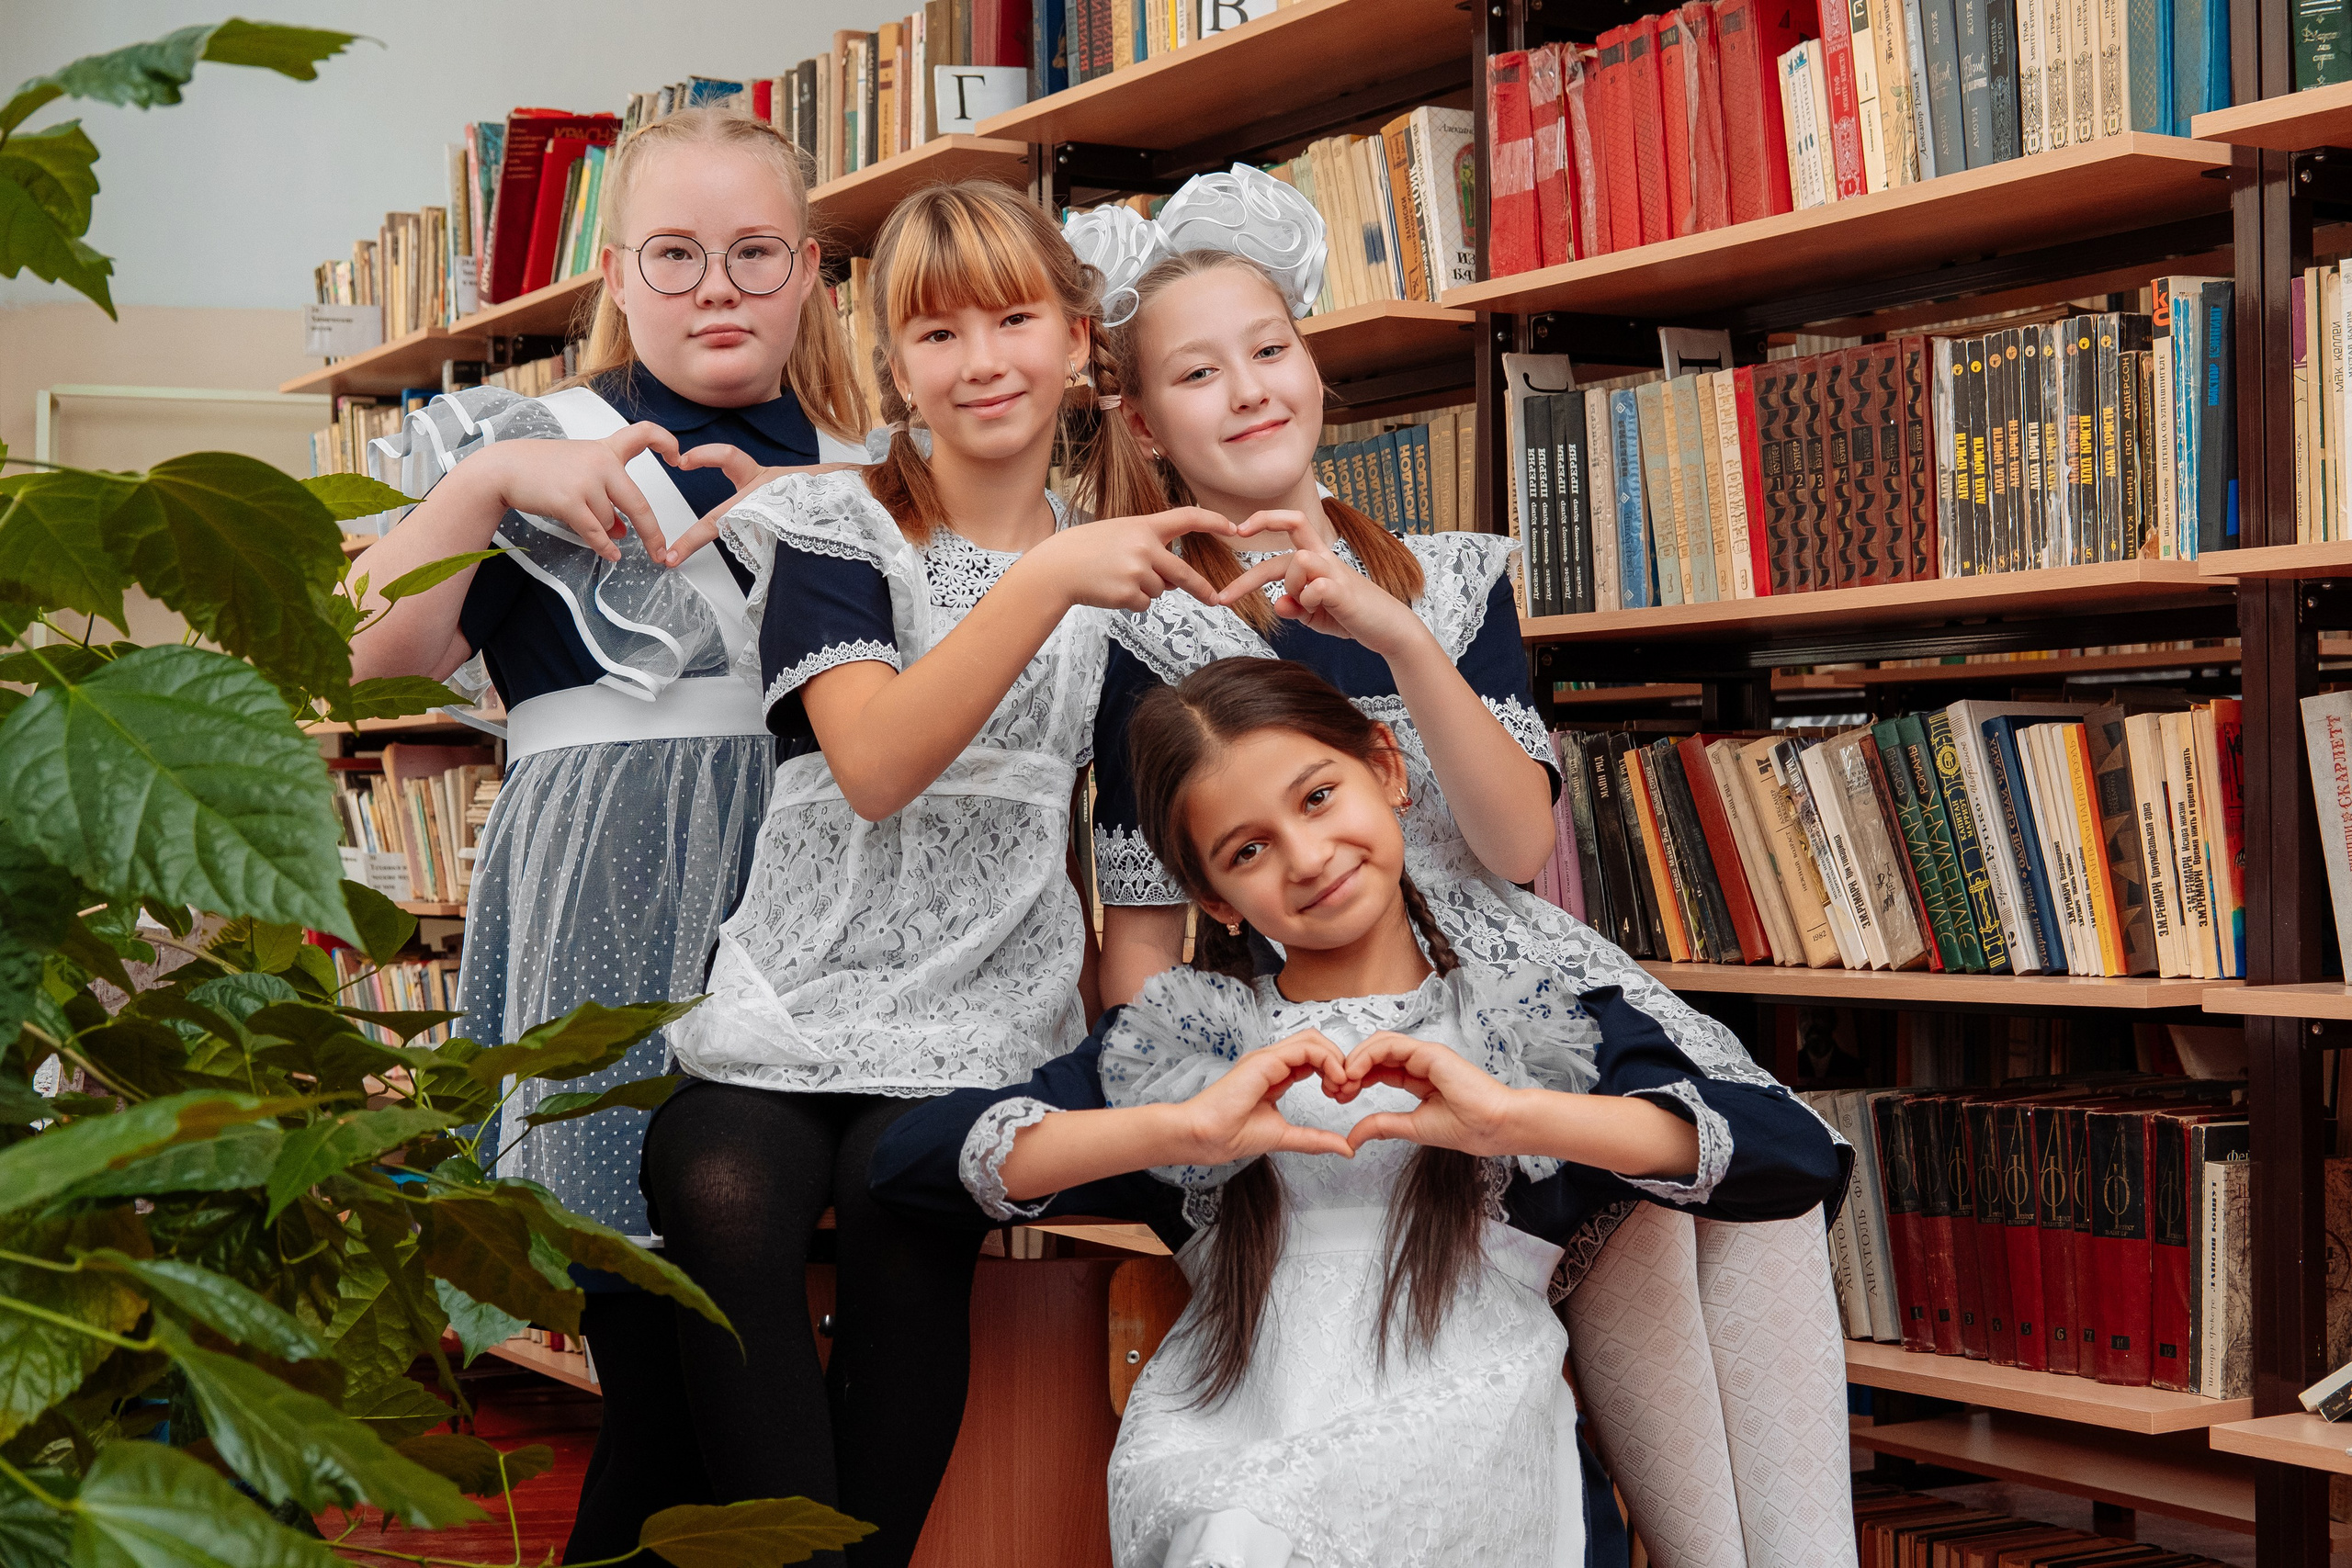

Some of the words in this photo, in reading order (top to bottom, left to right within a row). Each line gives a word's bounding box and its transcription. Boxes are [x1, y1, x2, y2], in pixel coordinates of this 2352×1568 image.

[1930, 10, 1939, 45] ЖОРЖ
[1965, 0, 1974, 36] ЖОРЖ
[1990, 17, 1999, 65] КОРОЛЕВА
[951, 73, 986, 120] Г
[1838, 53, 1849, 111] МОНТЕ-КРИСТО
[1917, 111, 1928, 160] Александр
[1971, 107, 1980, 148] АМОРИ
[1408, 163, 1423, 218] СТОИК
[1401, 196, 1411, 241] ЗАПИСКИ
[2210, 306, 2222, 358] КЭННИНГ
[2208, 363, 2220, 406] ВИКТОР
[1717, 382, 1739, 449] КУПЕР
[2103, 406, 2115, 446] КРИСТИ
[2162, 423, 2167, 434] ОБ
[1955, 433, 1967, 470] КРИСТИ
[1993, 427, 2004, 465] КРИСТИ
[2008, 419, 2019, 457] КРИСТИ
[2028, 422, 2040, 460] КРИСТИ
[2079, 415, 2092, 455] КРИСТИ
[1527, 447, 1538, 498] ПРЕРИЯ
[1537, 447, 1548, 498] ПРЕРИЯ
[1557, 444, 1566, 494] ПРЕРИЯ
[1568, 443, 1579, 494] ПРЕРИЯ
[1792, 441, 1803, 470] КУПЕР
[1891, 461, 1897, 474] 6
[1917, 457, 1924, 470] 7
[1973, 436, 1984, 475] КРИСТИ
[2080, 457, 2092, 485] АГАТА
[2104, 448, 2116, 478] АГАТА
[1399, 444, 1416, 520] ЛОНДОН
[1415, 444, 1430, 521] ЛОНДОН
[1777, 479, 1781, 490] 1
[1795, 475, 1804, 487] 2
[1816, 475, 1824, 487] 3
[1840, 469, 1849, 482] 4
[1957, 472, 1969, 500] АГАТА
[1975, 477, 1986, 504] АГАТА
[1995, 468, 2005, 495] АГАТА
[2009, 460, 2020, 488] АГАТА
[2030, 462, 2041, 491] АГАТА
[1725, 459, 1749, 555] ФЕНИМОР
[2164, 507, 2169, 515] де
[1594, 754, 1605, 775] РИД
[1647, 766, 1656, 789] СТРЕЛКИ
[1886, 748, 1906, 796] РОМАНЫ
[1907, 744, 1928, 795] РОМАНЫ
[1961, 741, 1978, 794] Избранное
[1988, 739, 2006, 785] ЧУЖИХ
[2182, 747, 2194, 781] умирать
[2325, 714, 2352, 809] СКАРЛЕТТ
[1600, 776, 1610, 799] МАЙН
[1723, 783, 1732, 800] РИД
[2070, 739, 2091, 827] ПАНТАГРЮЭЛЬ
[2187, 781, 2195, 805] время
[1653, 788, 1663, 816] ВОЛЬНЫЕ
[1727, 801, 1737, 819] МАЙН
[1959, 797, 1974, 839] МАРРИЭТ
[2001, 789, 2018, 829] СРЕДИ
[2143, 802, 2152, 821] арка
[2177, 800, 2187, 827] жизни
[1662, 827, 1670, 843] Рид
[1952, 800, 1967, 841] КАПИТАН
[1976, 802, 1996, 862] Рутько
[2190, 816, 2199, 838] жить
[1668, 844, 1677, 867] Майн
[1785, 831, 1798, 859] ВОЗРАСТ
[1834, 834, 1850, 866] товарища
[2012, 833, 2027, 869] ОДИН
[2144, 821, 2161, 880] Триумфальная
[2180, 828, 2190, 852] Искра
[2192, 839, 2202, 865] Время
[1794, 860, 1808, 892] НЕЖНЫЙ
[1843, 865, 1854, 880] Три
[1896, 790, 1956, 949] Э.М.РЕМАРК
[1918, 790, 1976, 948] Э.М.РЕМАРК
[2053, 840, 2066, 881] Возвращение
[2086, 834, 2102, 898] ГАРГАНТЮА
[1671, 867, 1682, 894] Томас
[1990, 863, 2007, 906] Арсений
[2023, 881, 2038, 914] Реняк
[2193, 868, 2209, 927] Э.М.РЕМАРК
[1848, 880, 1871, 930] Э.М.РЕМАРК
[2061, 882, 2076, 924] Э.М.РЕМАРК
[2150, 877, 2169, 937] Э.М.РЕМАРК
[1623, 917, 1630, 933] 4
[1656, 919, 1661, 934] 4
[1813, 930, 1827, 942] 1982
[2007, 931, 2018, 949] 2
[2031, 917, 2050, 967] Мариан
[1858, 1209, 1877, 1297] АНАТОЛЬ
[1966, 1314, 1973, 1324] 3
[2023, 1324, 2030, 1334] 5
[2056, 1328, 2064, 1340] 6
[2208, 1299, 2216, 1339] Фекете
[2163, 1346, 2174, 1357] 12
